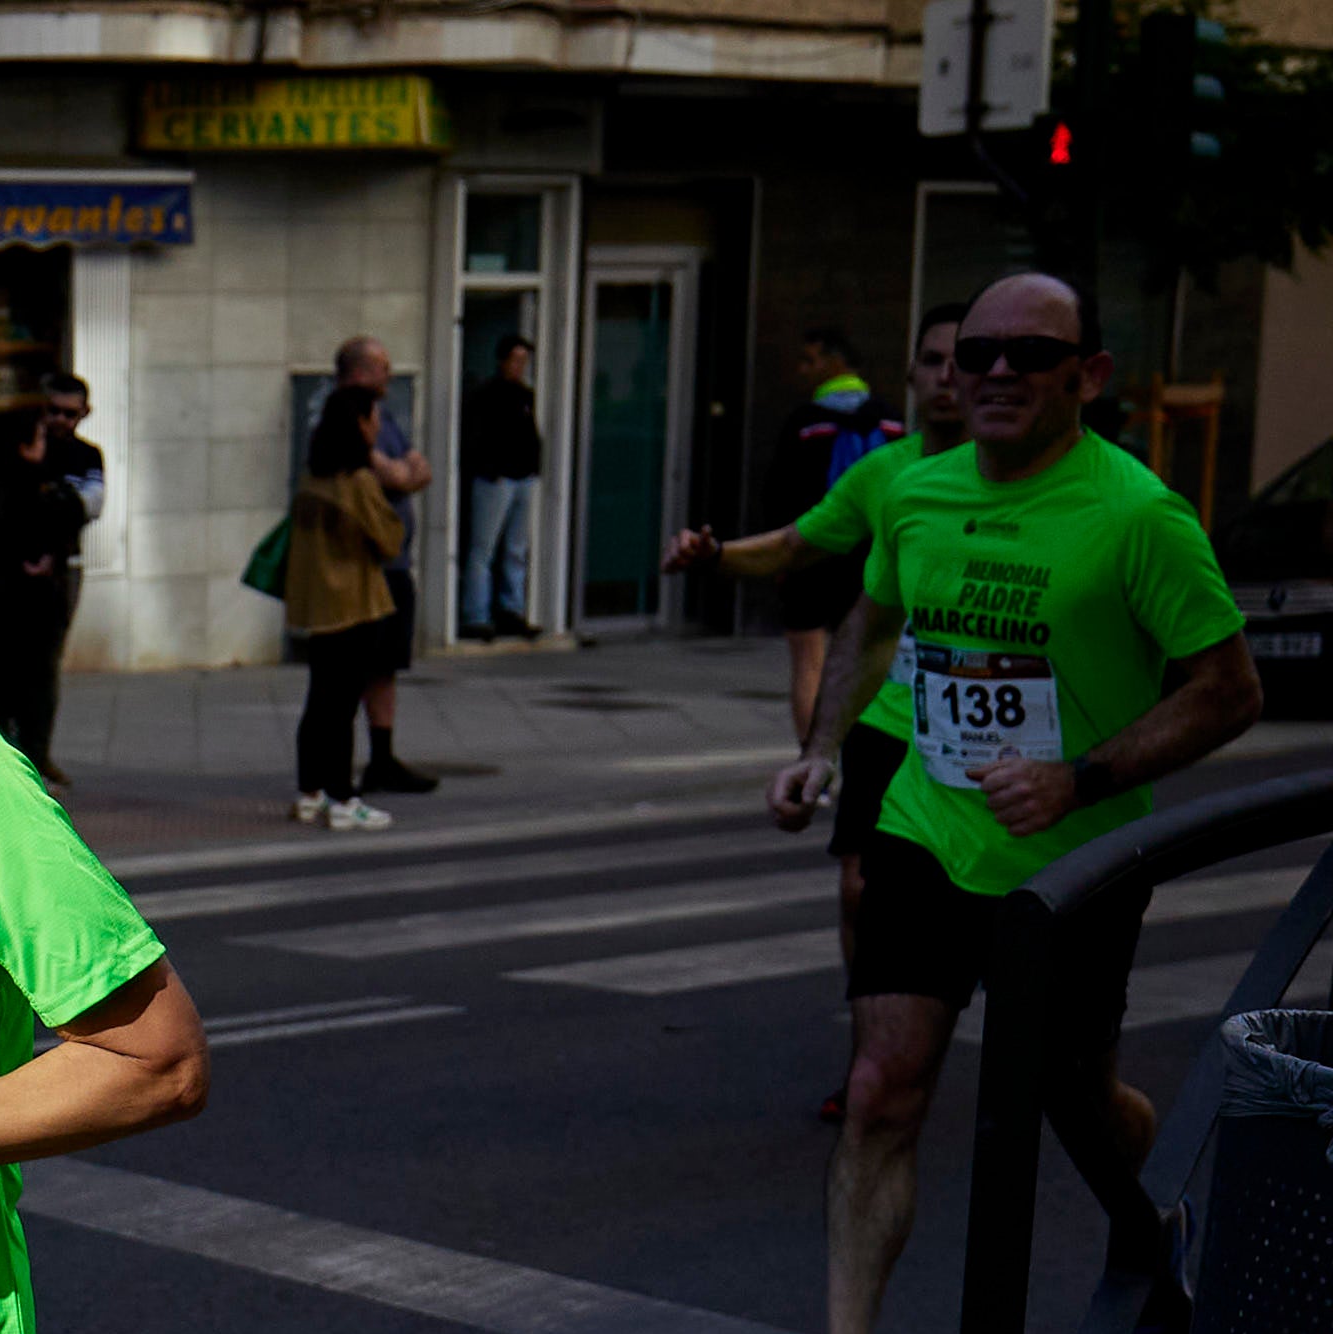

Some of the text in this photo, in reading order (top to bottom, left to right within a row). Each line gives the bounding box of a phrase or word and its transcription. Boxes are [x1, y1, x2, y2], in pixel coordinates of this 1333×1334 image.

[164, 110, 399, 144] CERVANTES
[962, 559, 1053, 589] MEMORIAL
[958, 580, 1043, 618] PADRE
[912, 606, 1051, 646] MARCELINO
[942, 681, 1026, 728] 138
